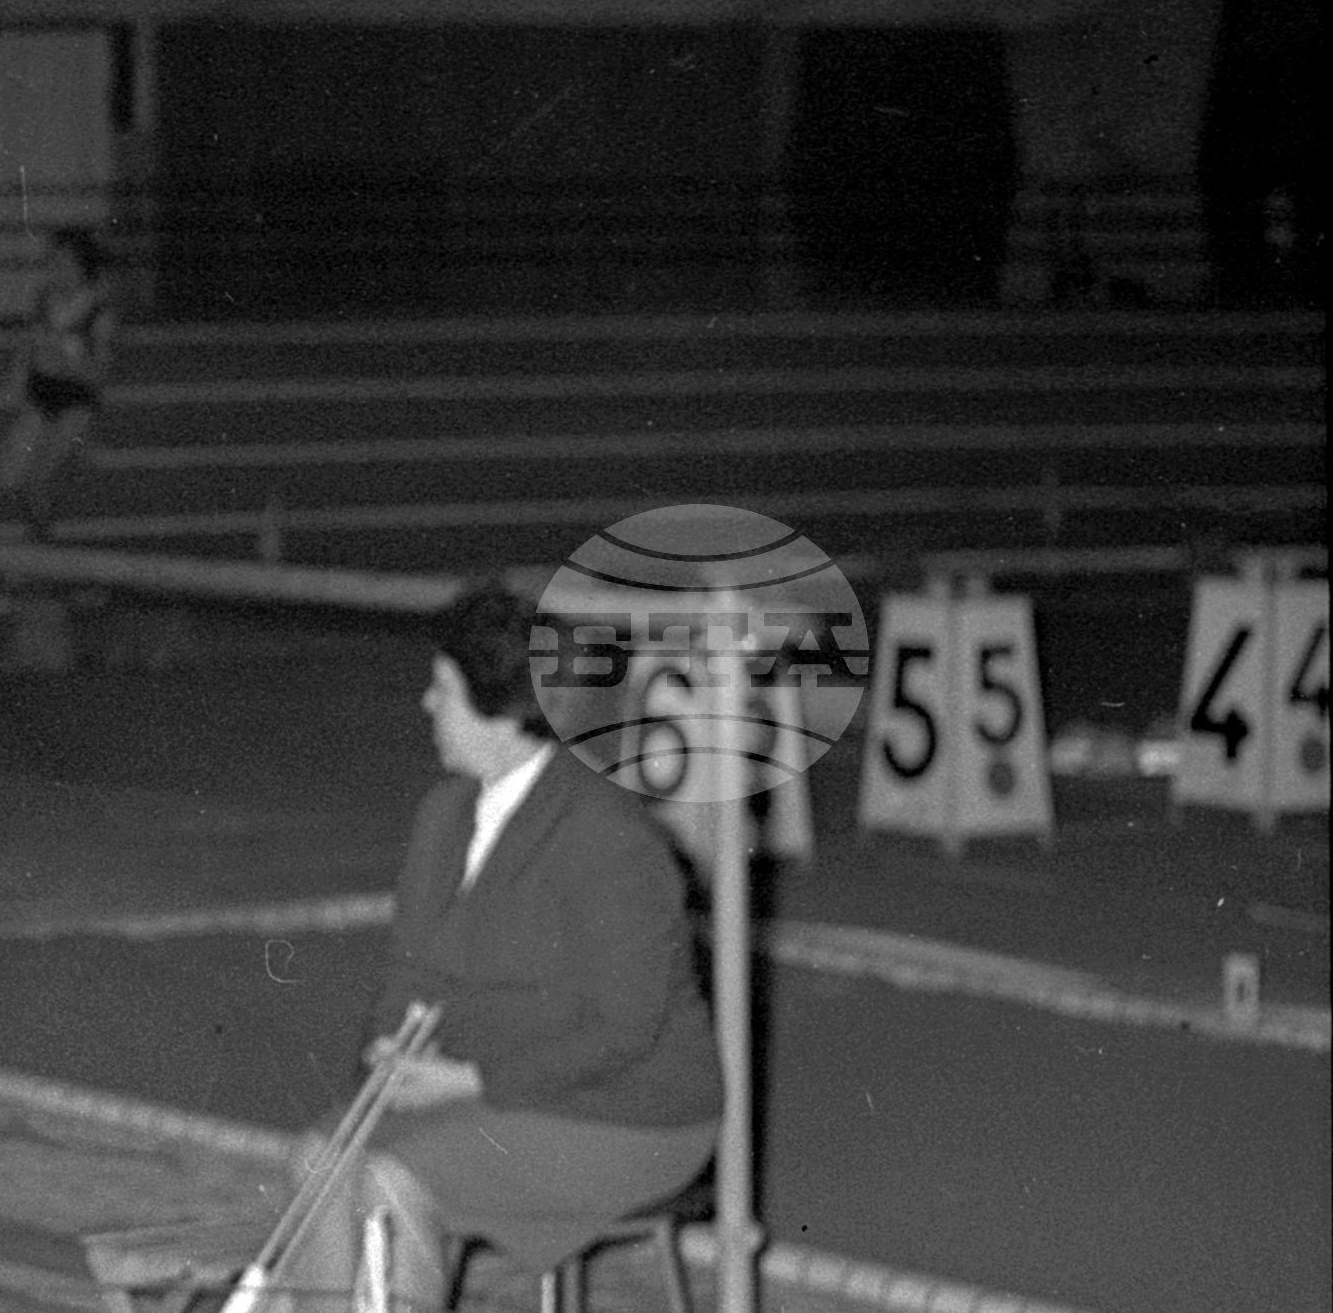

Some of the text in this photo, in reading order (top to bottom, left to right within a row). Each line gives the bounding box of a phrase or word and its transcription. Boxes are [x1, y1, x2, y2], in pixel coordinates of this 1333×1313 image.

[883, 645, 937, 779] 5
[976, 644, 1023, 746] 5
[1190, 628, 1250, 761] 4
